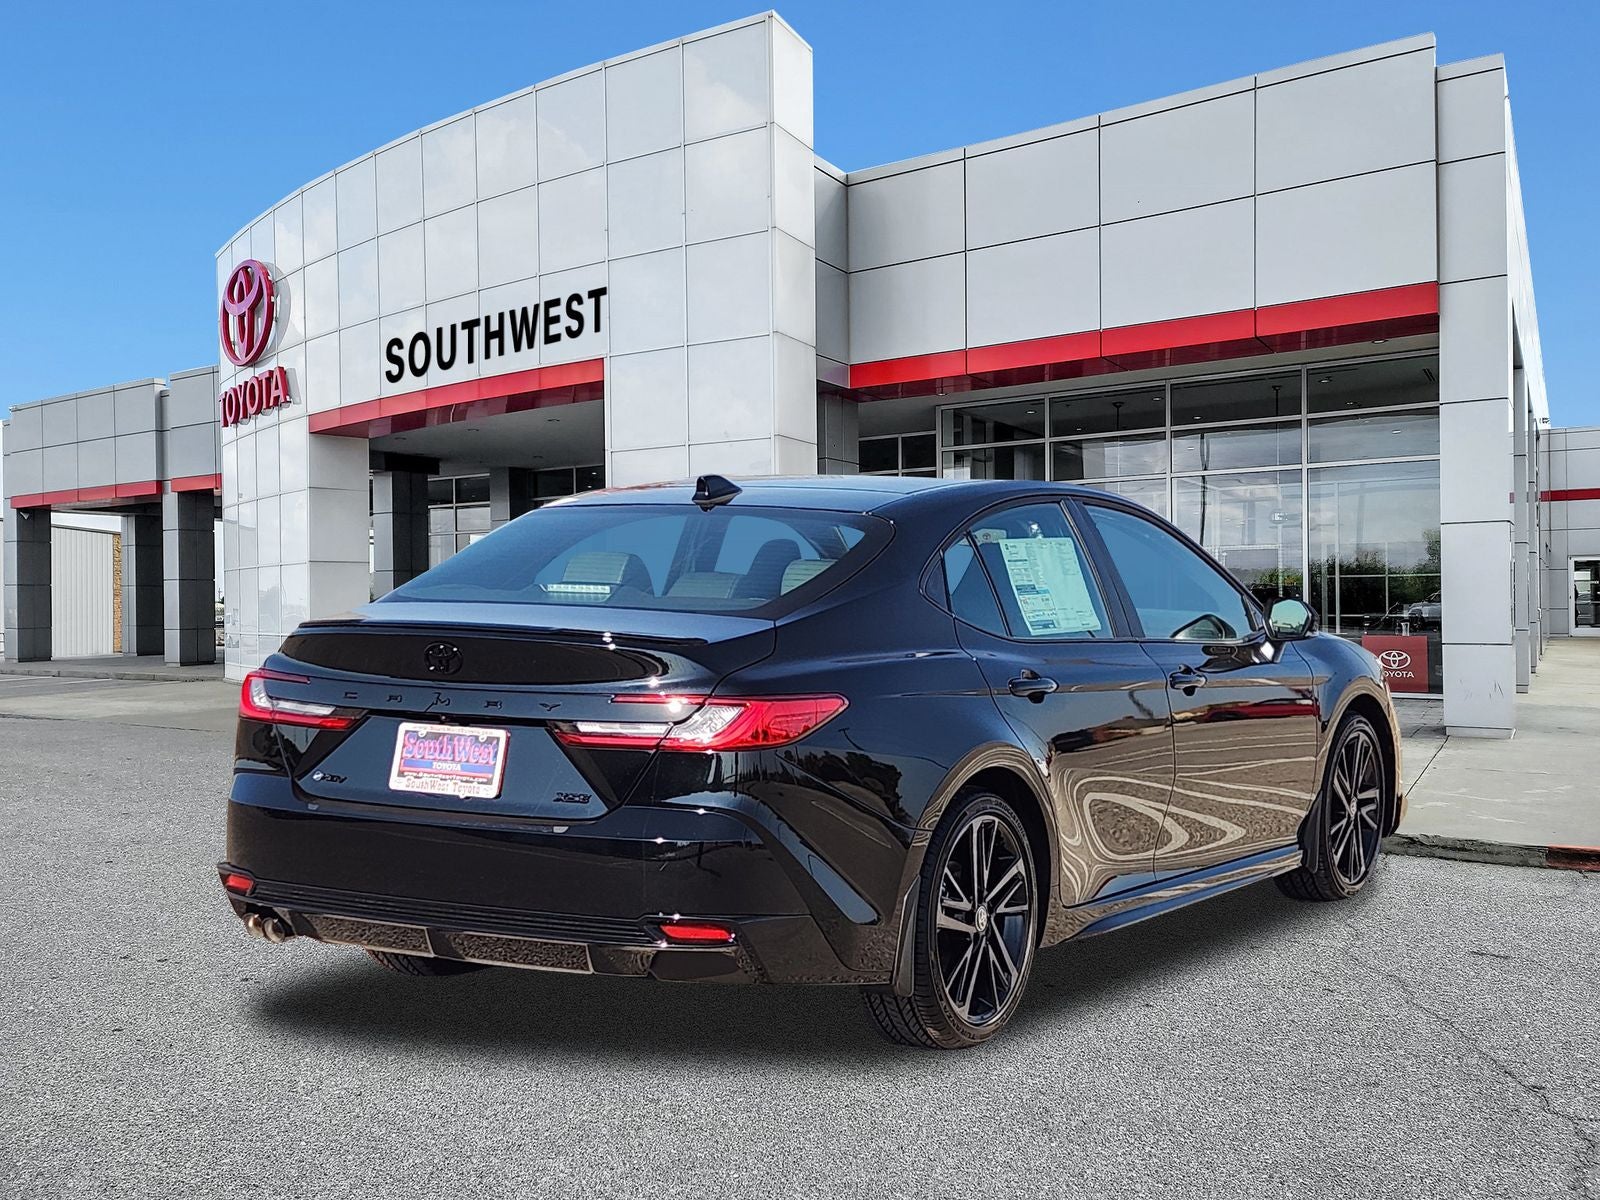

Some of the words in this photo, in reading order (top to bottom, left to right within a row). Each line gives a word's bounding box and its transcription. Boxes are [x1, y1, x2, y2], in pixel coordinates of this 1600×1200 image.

[385, 286, 607, 384] SOUTHWEST
[218, 366, 292, 428] TOYOTA
[1383, 670, 1414, 678] OYOTA
[432, 762, 462, 771] TOYOTA
[452, 781, 481, 795] Toyota
